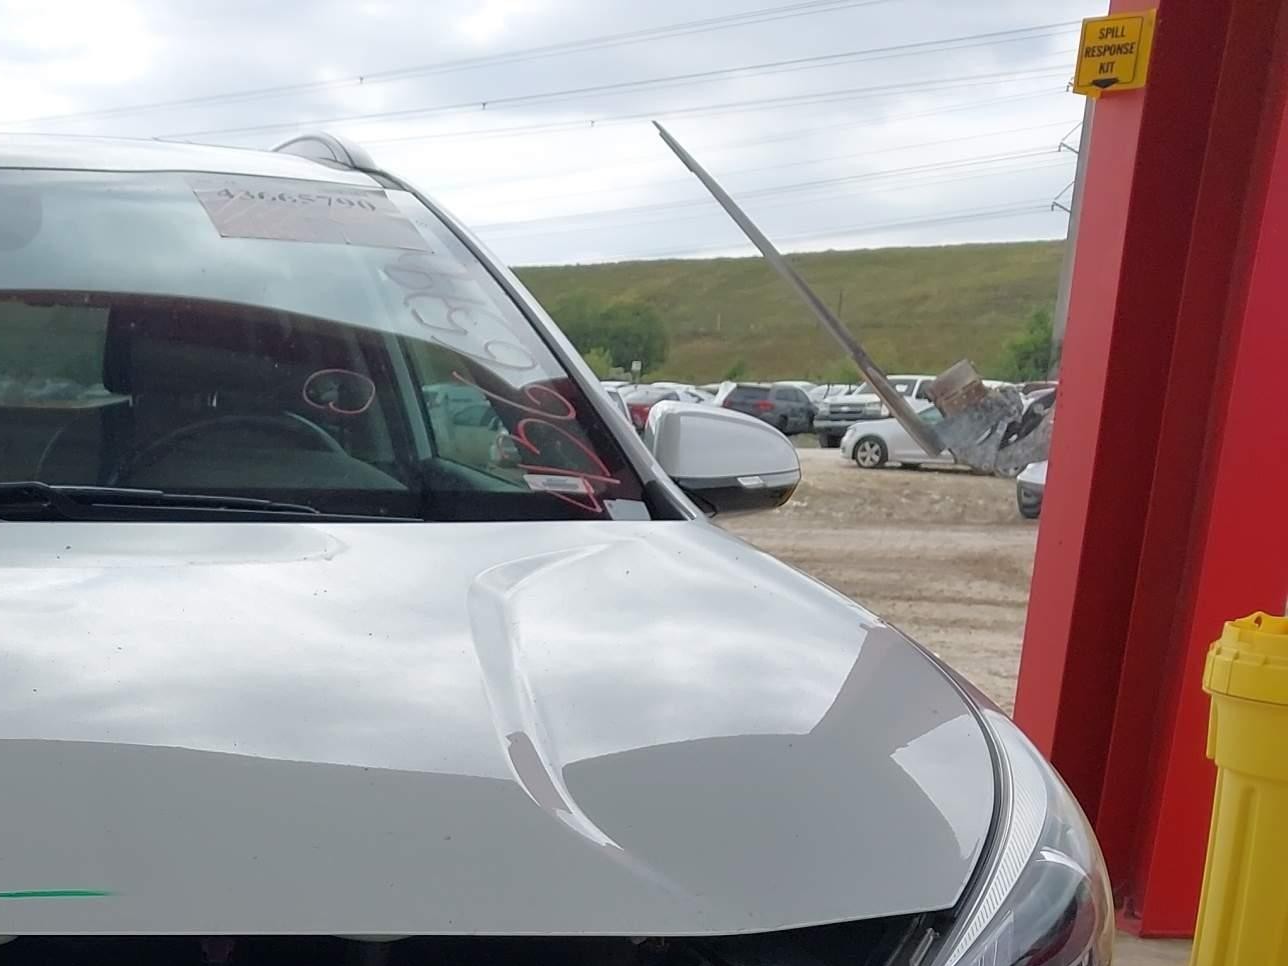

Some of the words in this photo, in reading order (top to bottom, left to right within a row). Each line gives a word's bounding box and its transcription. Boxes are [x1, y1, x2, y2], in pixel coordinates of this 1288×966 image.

[1099, 27, 1126, 39] SPILL
[1085, 42, 1135, 57] RESPONSE
[1099, 62, 1114, 74] KIT
